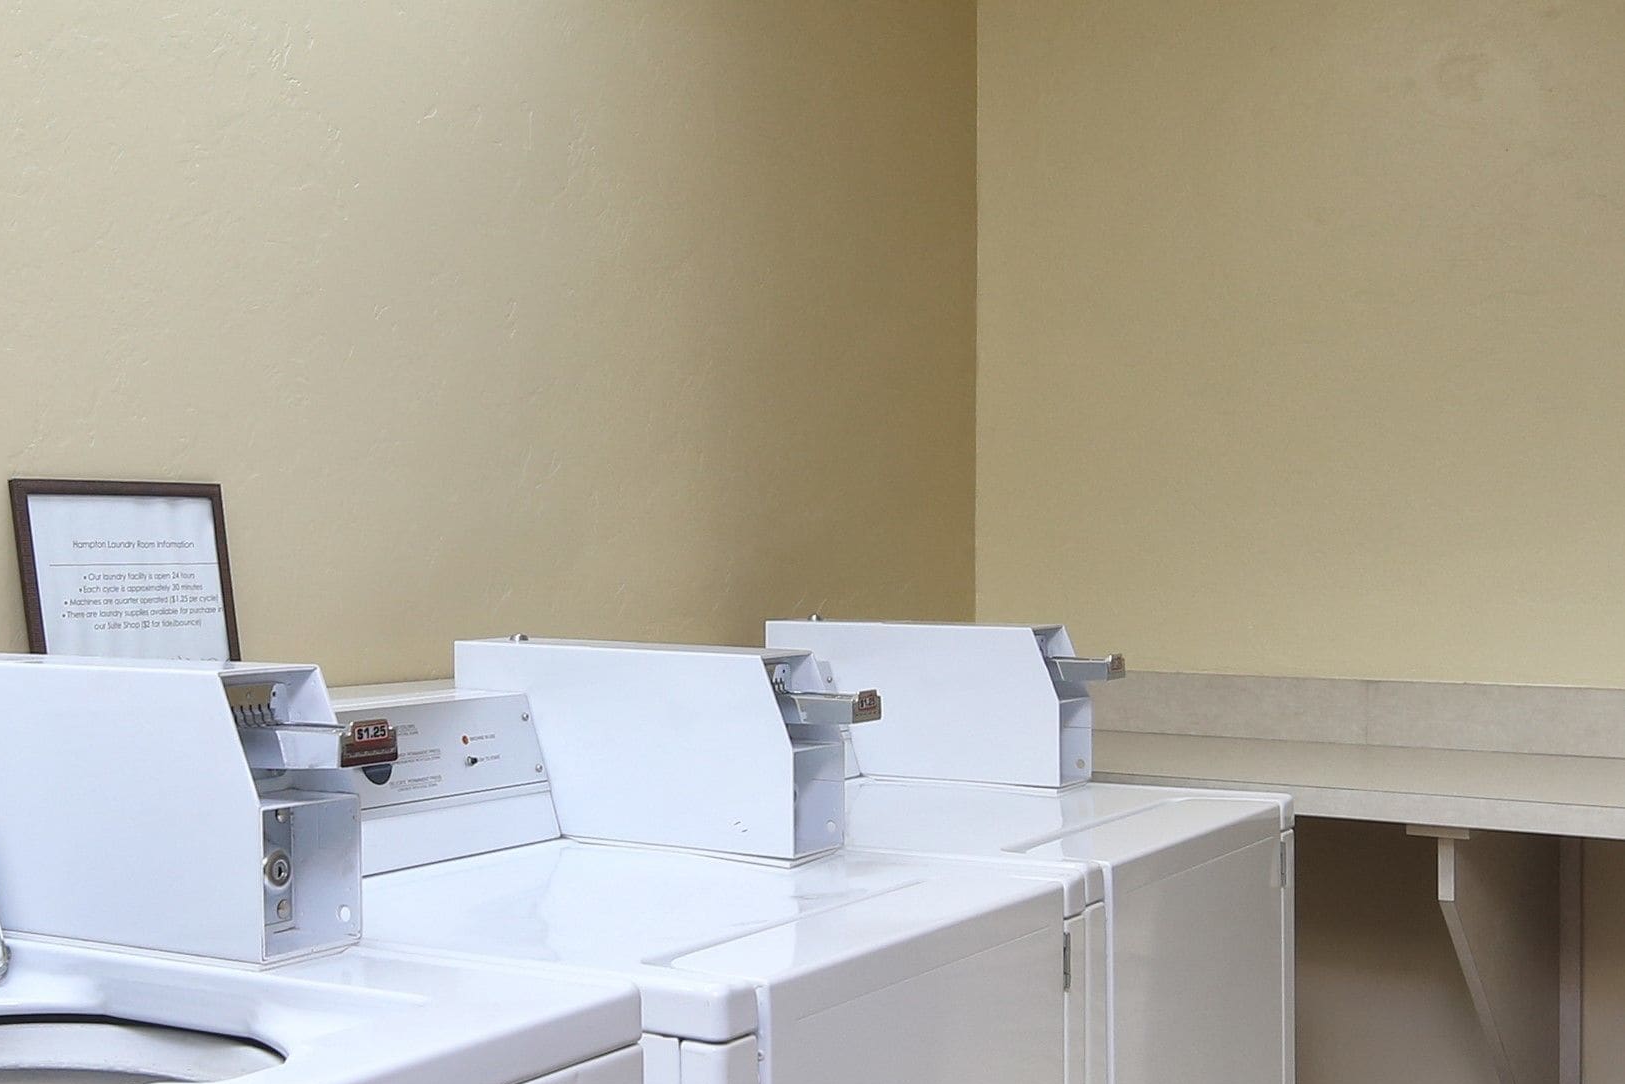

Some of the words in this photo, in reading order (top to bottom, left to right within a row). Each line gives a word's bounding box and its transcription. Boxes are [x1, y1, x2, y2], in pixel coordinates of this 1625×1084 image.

[103, 573, 126, 581] laundry
[128, 572, 146, 581] facility
[126, 584, 170, 593] approximately
[114, 597, 140, 606] quarter
[140, 596, 168, 605] operated
[99, 609, 122, 618] laundry
[150, 607, 178, 615] available
[189, 606, 216, 614] purchase
[123, 621, 140, 629] Shop
[357, 726, 386, 740] $1.25
